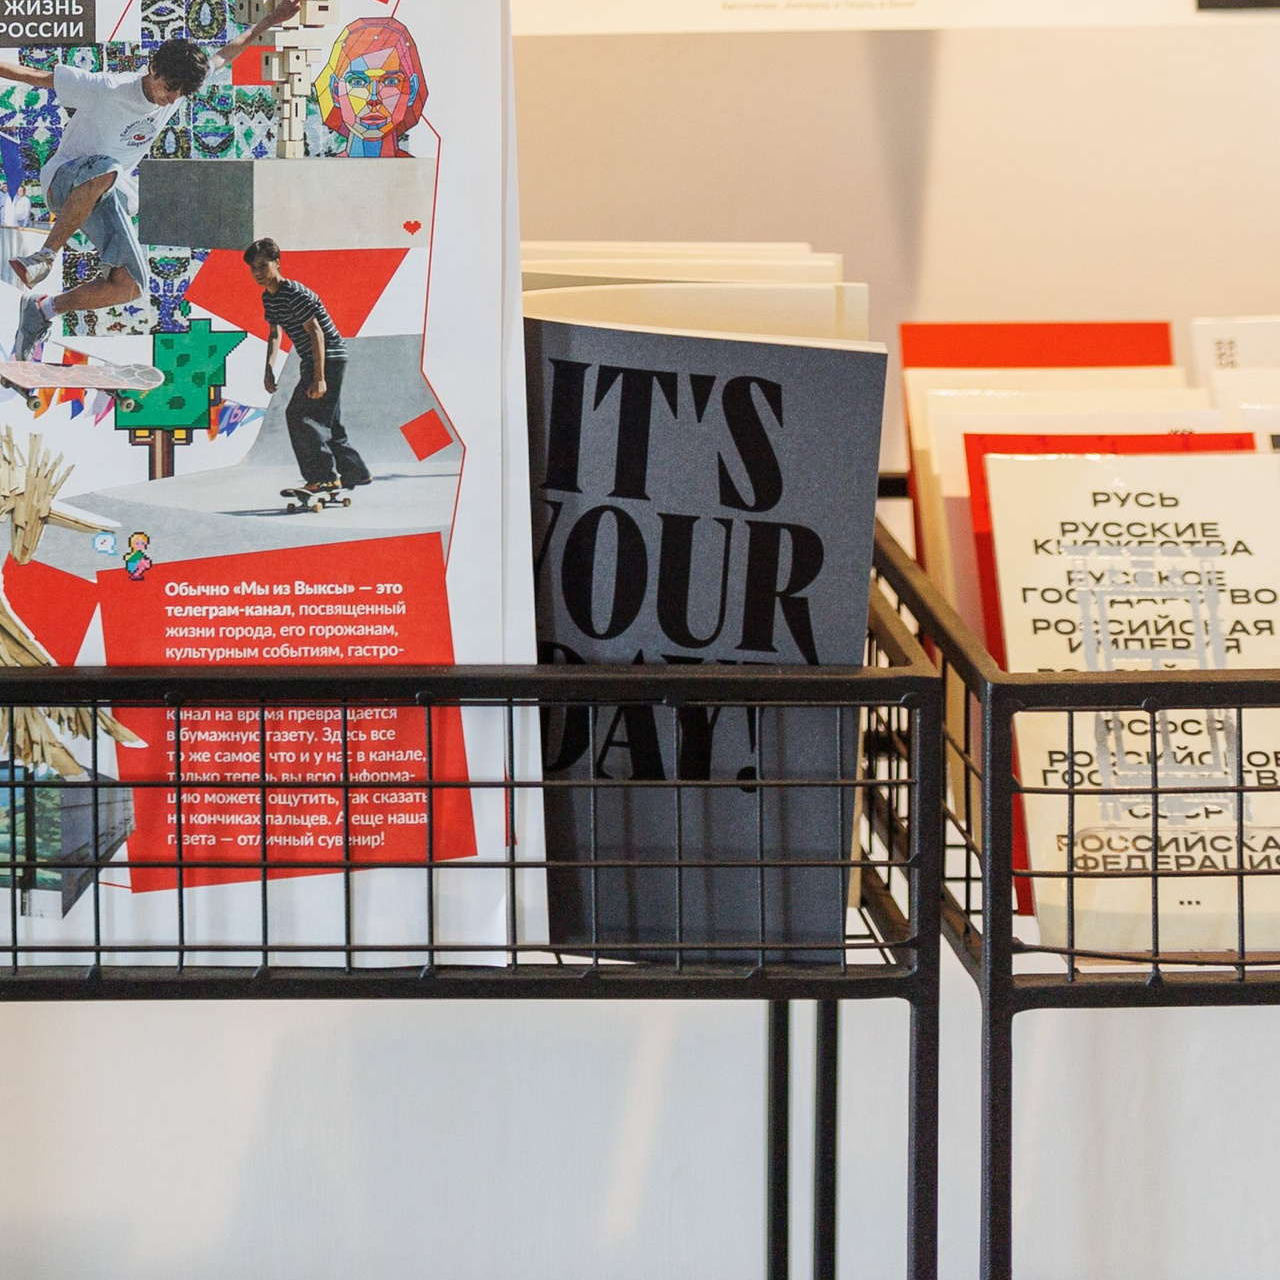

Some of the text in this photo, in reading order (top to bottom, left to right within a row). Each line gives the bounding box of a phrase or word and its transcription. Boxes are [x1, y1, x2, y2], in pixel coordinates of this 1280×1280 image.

[4, 0, 84, 16] ЖИЗНЬ
[540, 357, 784, 513] IT'S
[1092, 492, 1179, 508] РУСЬ
[1060, 522, 1220, 538] РУССКИЕ
[165, 582, 229, 596] Обычно
[233, 581, 269, 595] «Мы
[273, 583, 290, 595] из
[294, 581, 355, 595] Выксы»
[376, 583, 403, 594] это
[534, 499, 825, 665] OUR
[165, 601, 406, 620] телеграм-канал, посвященный
[165, 624, 399, 640] жизни города, его горожанам,
[165, 643, 405, 661] культурным событиям, гастро-
[215, 709, 233, 721] на
[266, 730, 318, 745] газету.
[371, 729, 396, 741] все
[189, 751, 211, 762] же
[269, 751, 296, 763] что
[300, 751, 310, 762] и
[314, 751, 323, 766] у
[357, 751, 366, 761] в
[370, 749, 427, 763] канале,
[268, 792, 340, 807] ощутить,
[190, 812, 261, 825] кончиках
[265, 813, 332, 827] пальцев.
[351, 813, 384, 827] еще
